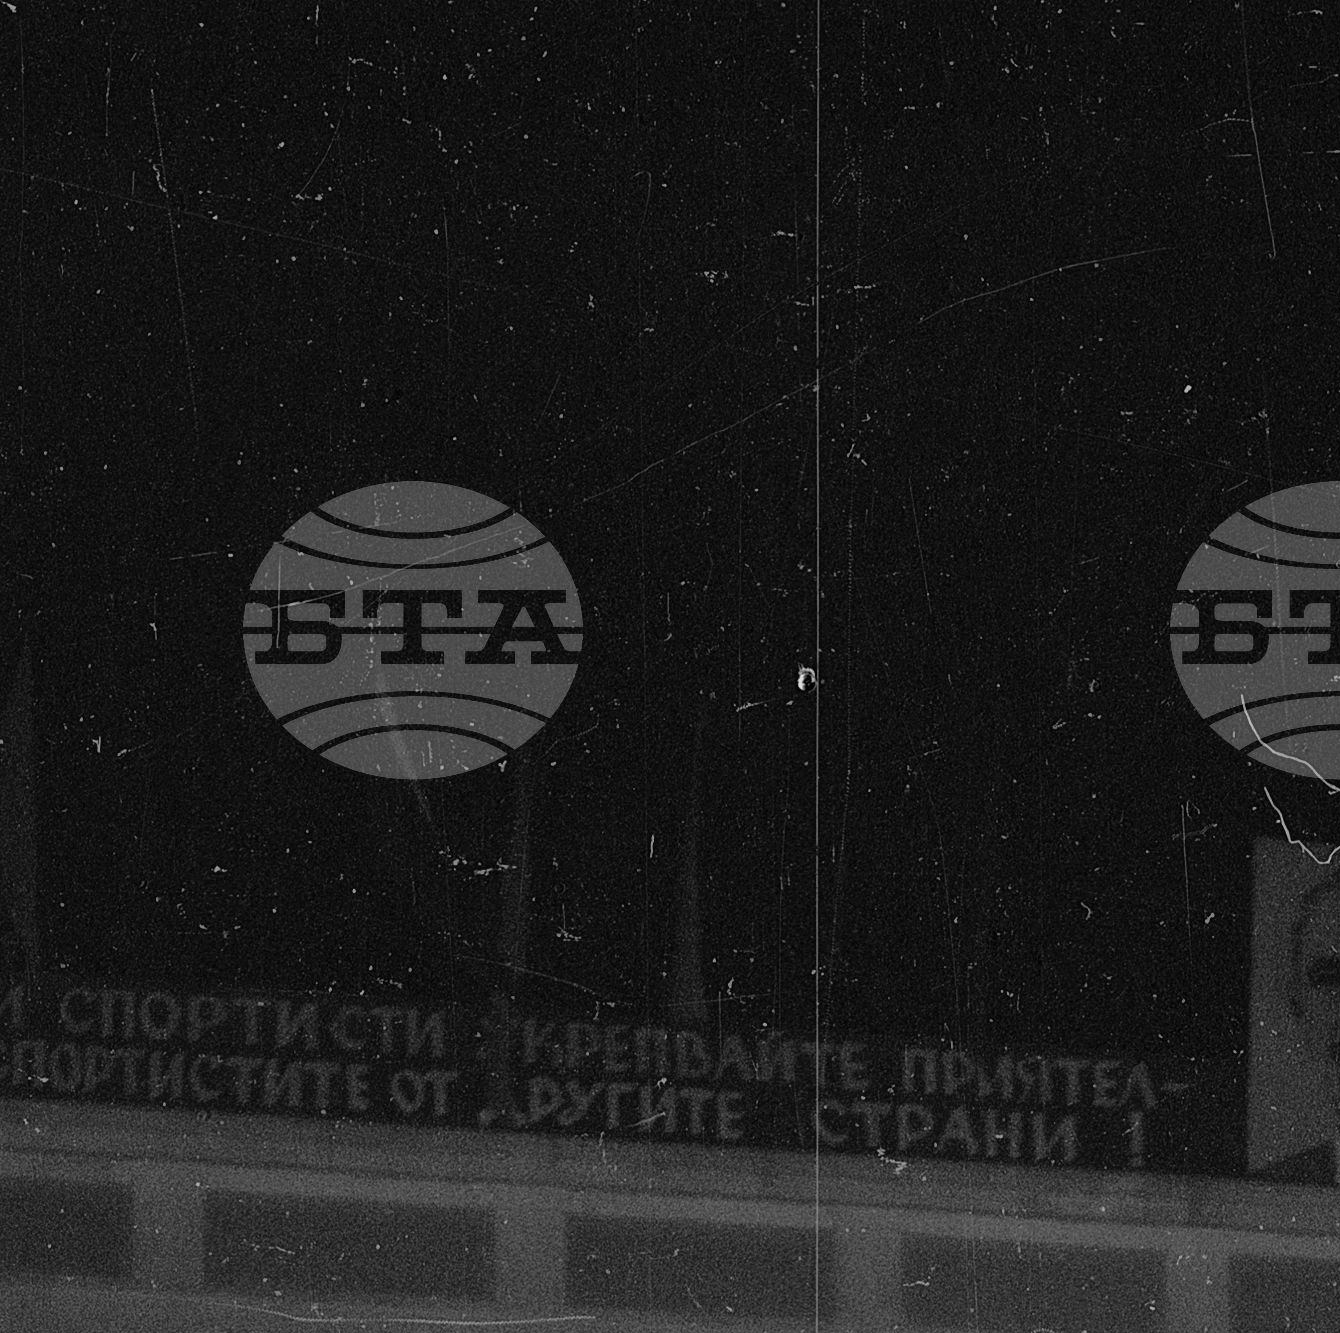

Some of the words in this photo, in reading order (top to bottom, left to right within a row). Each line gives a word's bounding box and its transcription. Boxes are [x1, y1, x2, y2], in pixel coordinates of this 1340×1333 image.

[59, 987, 446, 1058] СПОРТИСТИ
[0, 1040, 371, 1112] ПОРТИСТИТЕ
[390, 1069, 459, 1117] ОТ
[811, 1100, 1078, 1162] СТРАНИ
